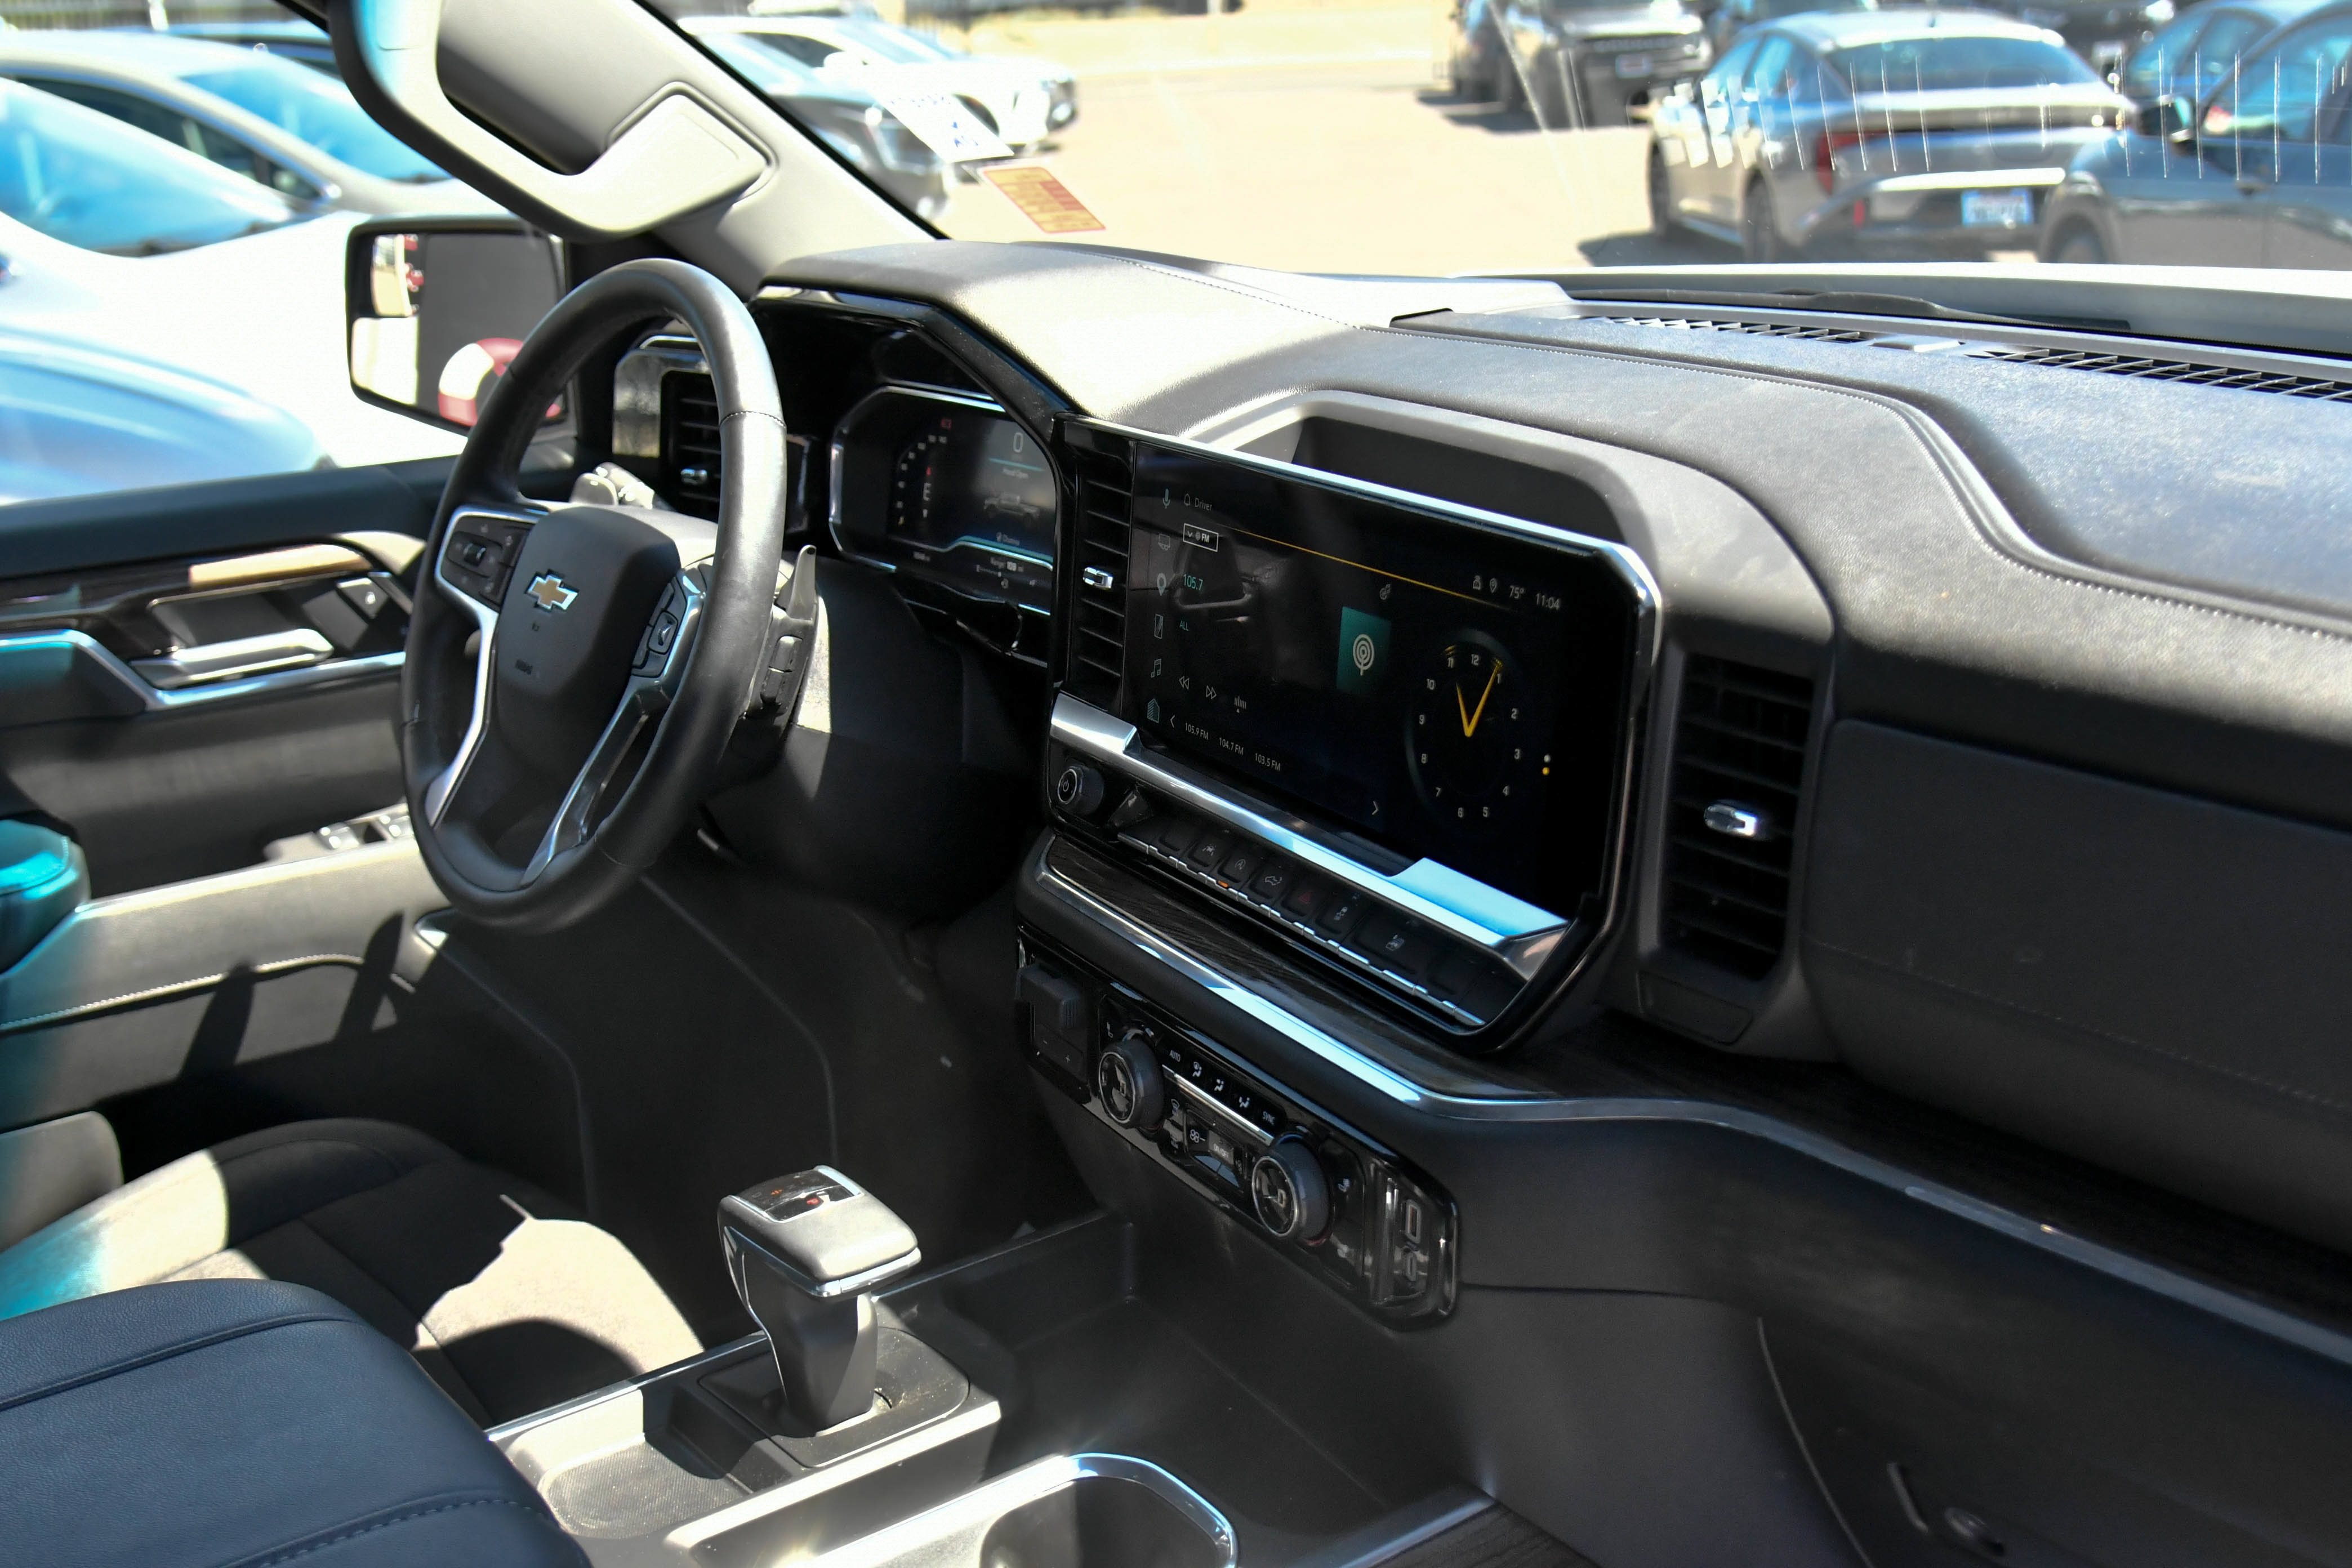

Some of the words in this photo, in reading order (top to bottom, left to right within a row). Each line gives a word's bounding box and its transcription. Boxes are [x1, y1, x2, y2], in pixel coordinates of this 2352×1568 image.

[1195, 497, 1213, 511] Driver
[1201, 533, 1209, 544] FM
[1183, 574, 1204, 591] 105.7
[1536, 593, 1561, 610] 11:04
[1447, 657, 1455, 669] 11
[1471, 654, 1480, 666] 12
[1427, 678, 1436, 691] 10
[1419, 714, 1426, 725] 9
[1511, 708, 1518, 720] 2
[1185, 723, 1200, 736] 105.9
[1200, 729, 1209, 740] FM
[1219, 737, 1234, 751] 104.7
[1235, 744, 1244, 756] FM
[1420, 753, 1428, 764] 8
[1514, 748, 1521, 761] 3
[1255, 753, 1271, 767] 103.5
[1271, 760, 1281, 772] FM
[1436, 786, 1442, 798] 7
[1502, 785, 1509, 797] 4
[1457, 807, 1465, 818] 6
[1482, 806, 1490, 818] 5
[1169, 1049, 1181, 1063] AUTO
